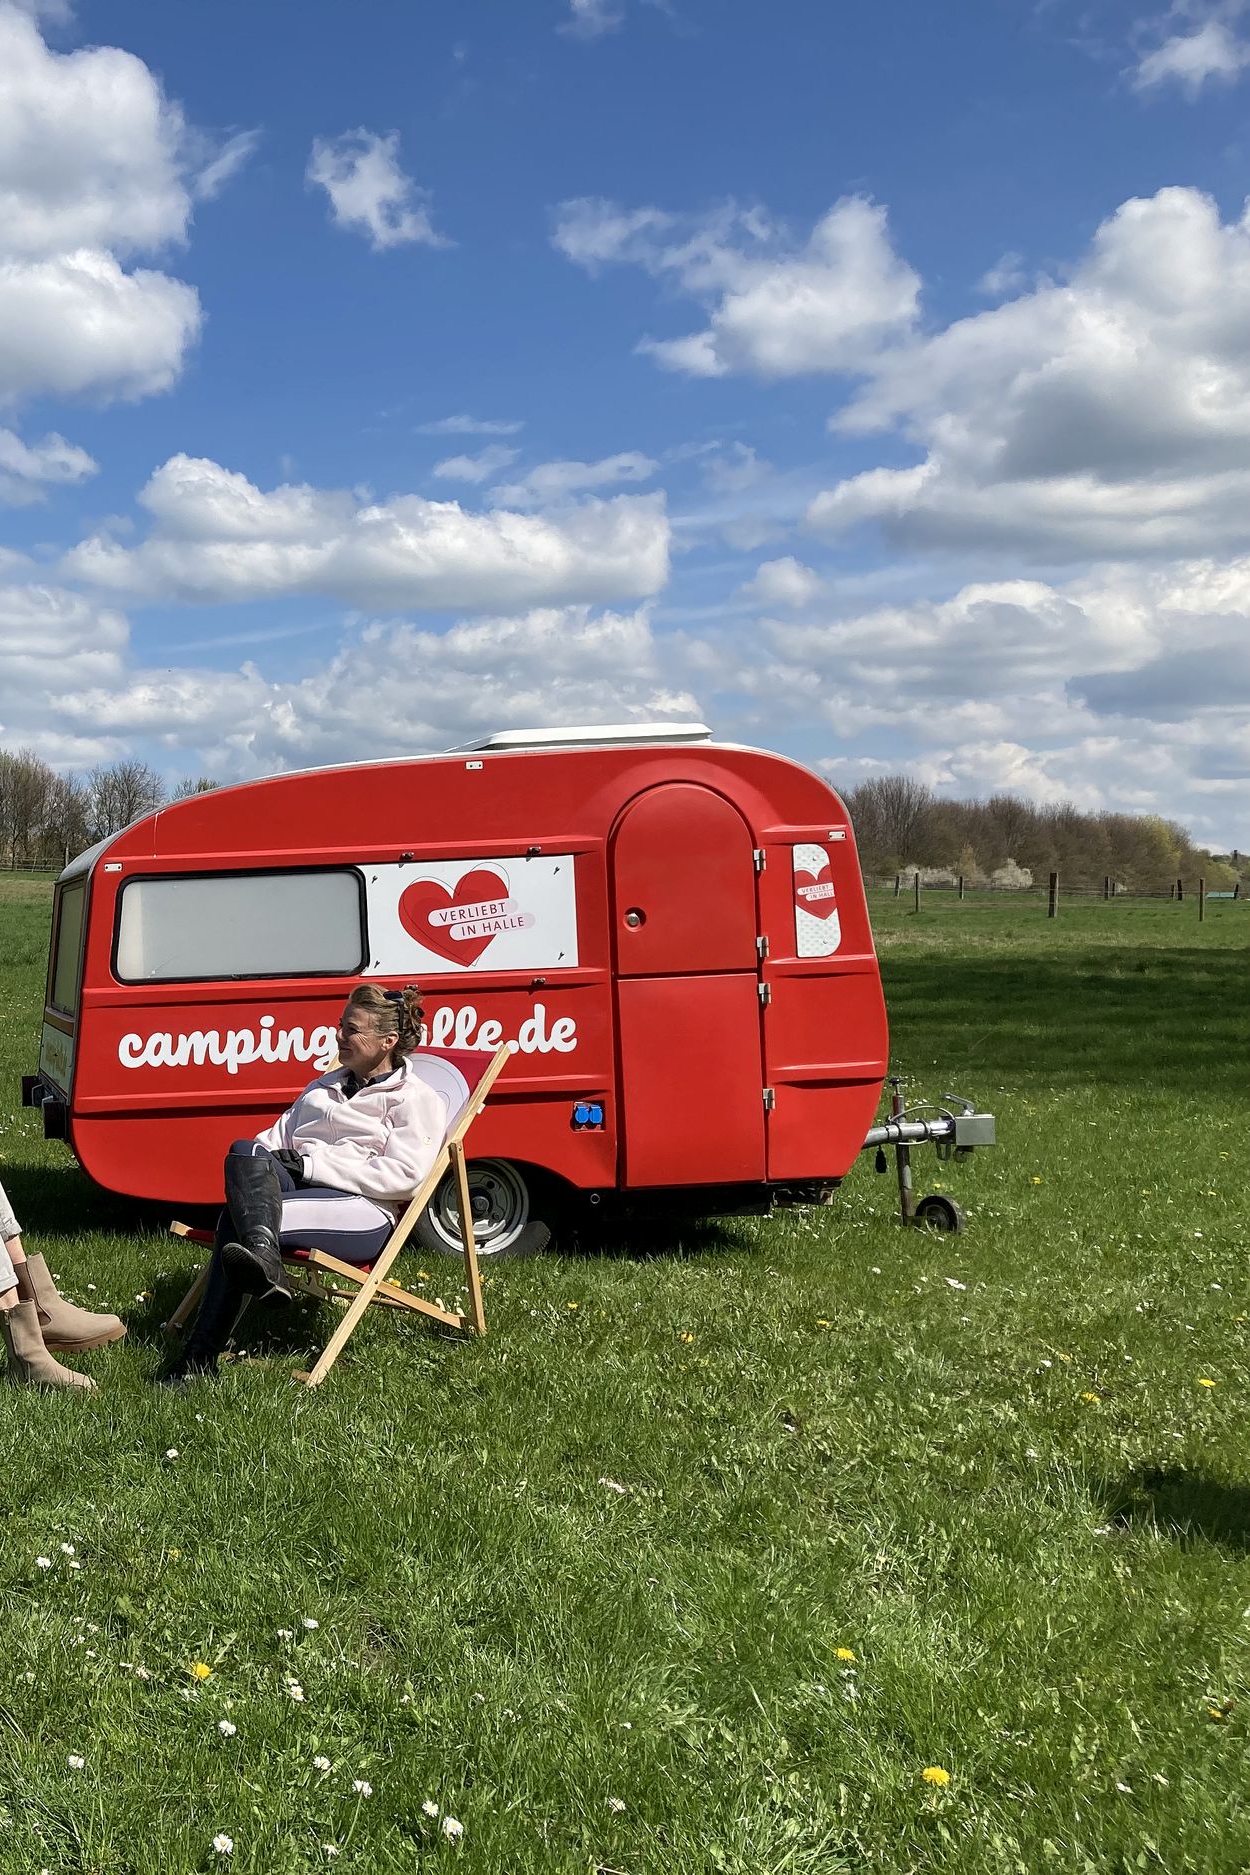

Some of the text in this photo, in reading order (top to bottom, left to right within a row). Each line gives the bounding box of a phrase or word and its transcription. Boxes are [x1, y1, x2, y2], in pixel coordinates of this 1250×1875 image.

[801, 885, 829, 893] VERLIEBT
[439, 902, 506, 922] VERLIEBT
[461, 916, 525, 936] IN HALLE
